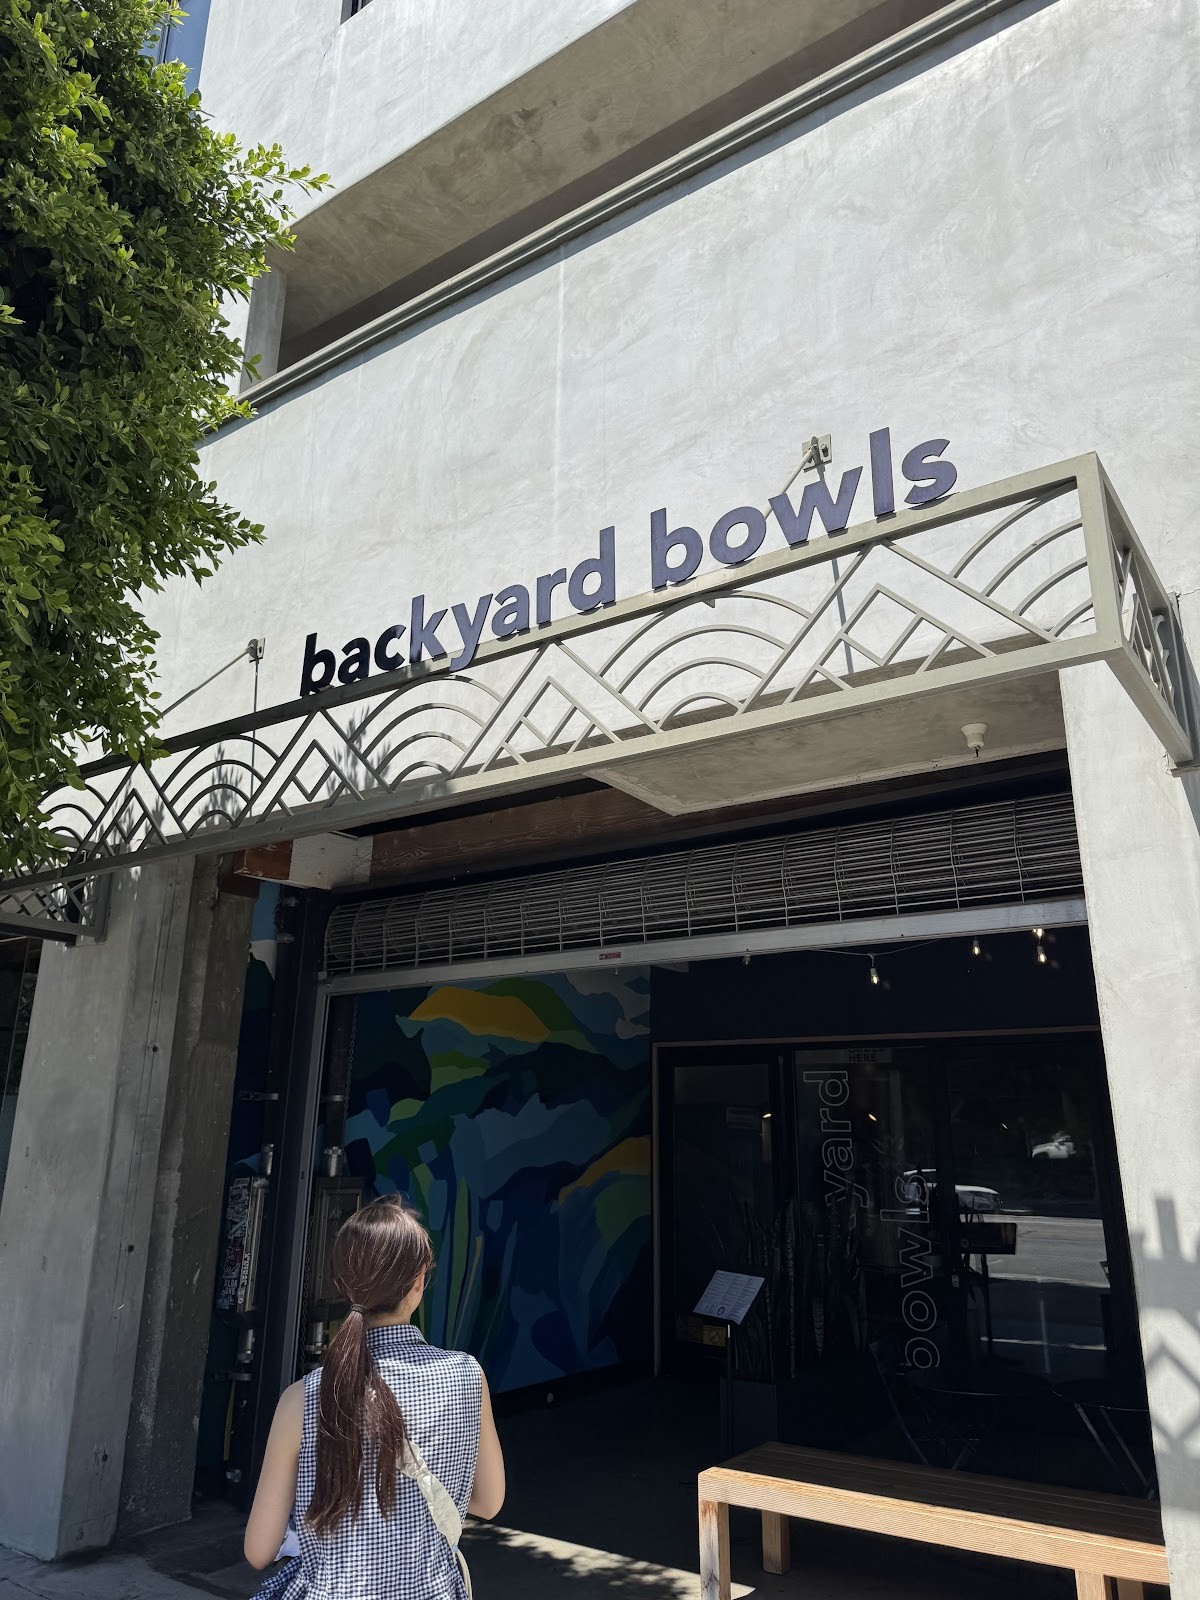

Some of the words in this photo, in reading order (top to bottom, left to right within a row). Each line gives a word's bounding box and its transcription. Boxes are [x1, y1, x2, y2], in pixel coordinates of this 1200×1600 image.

[301, 526, 616, 696] backyard
[650, 427, 958, 590] bowls
[849, 1054, 877, 1062] HERE
[880, 1174, 940, 1375] bowls
